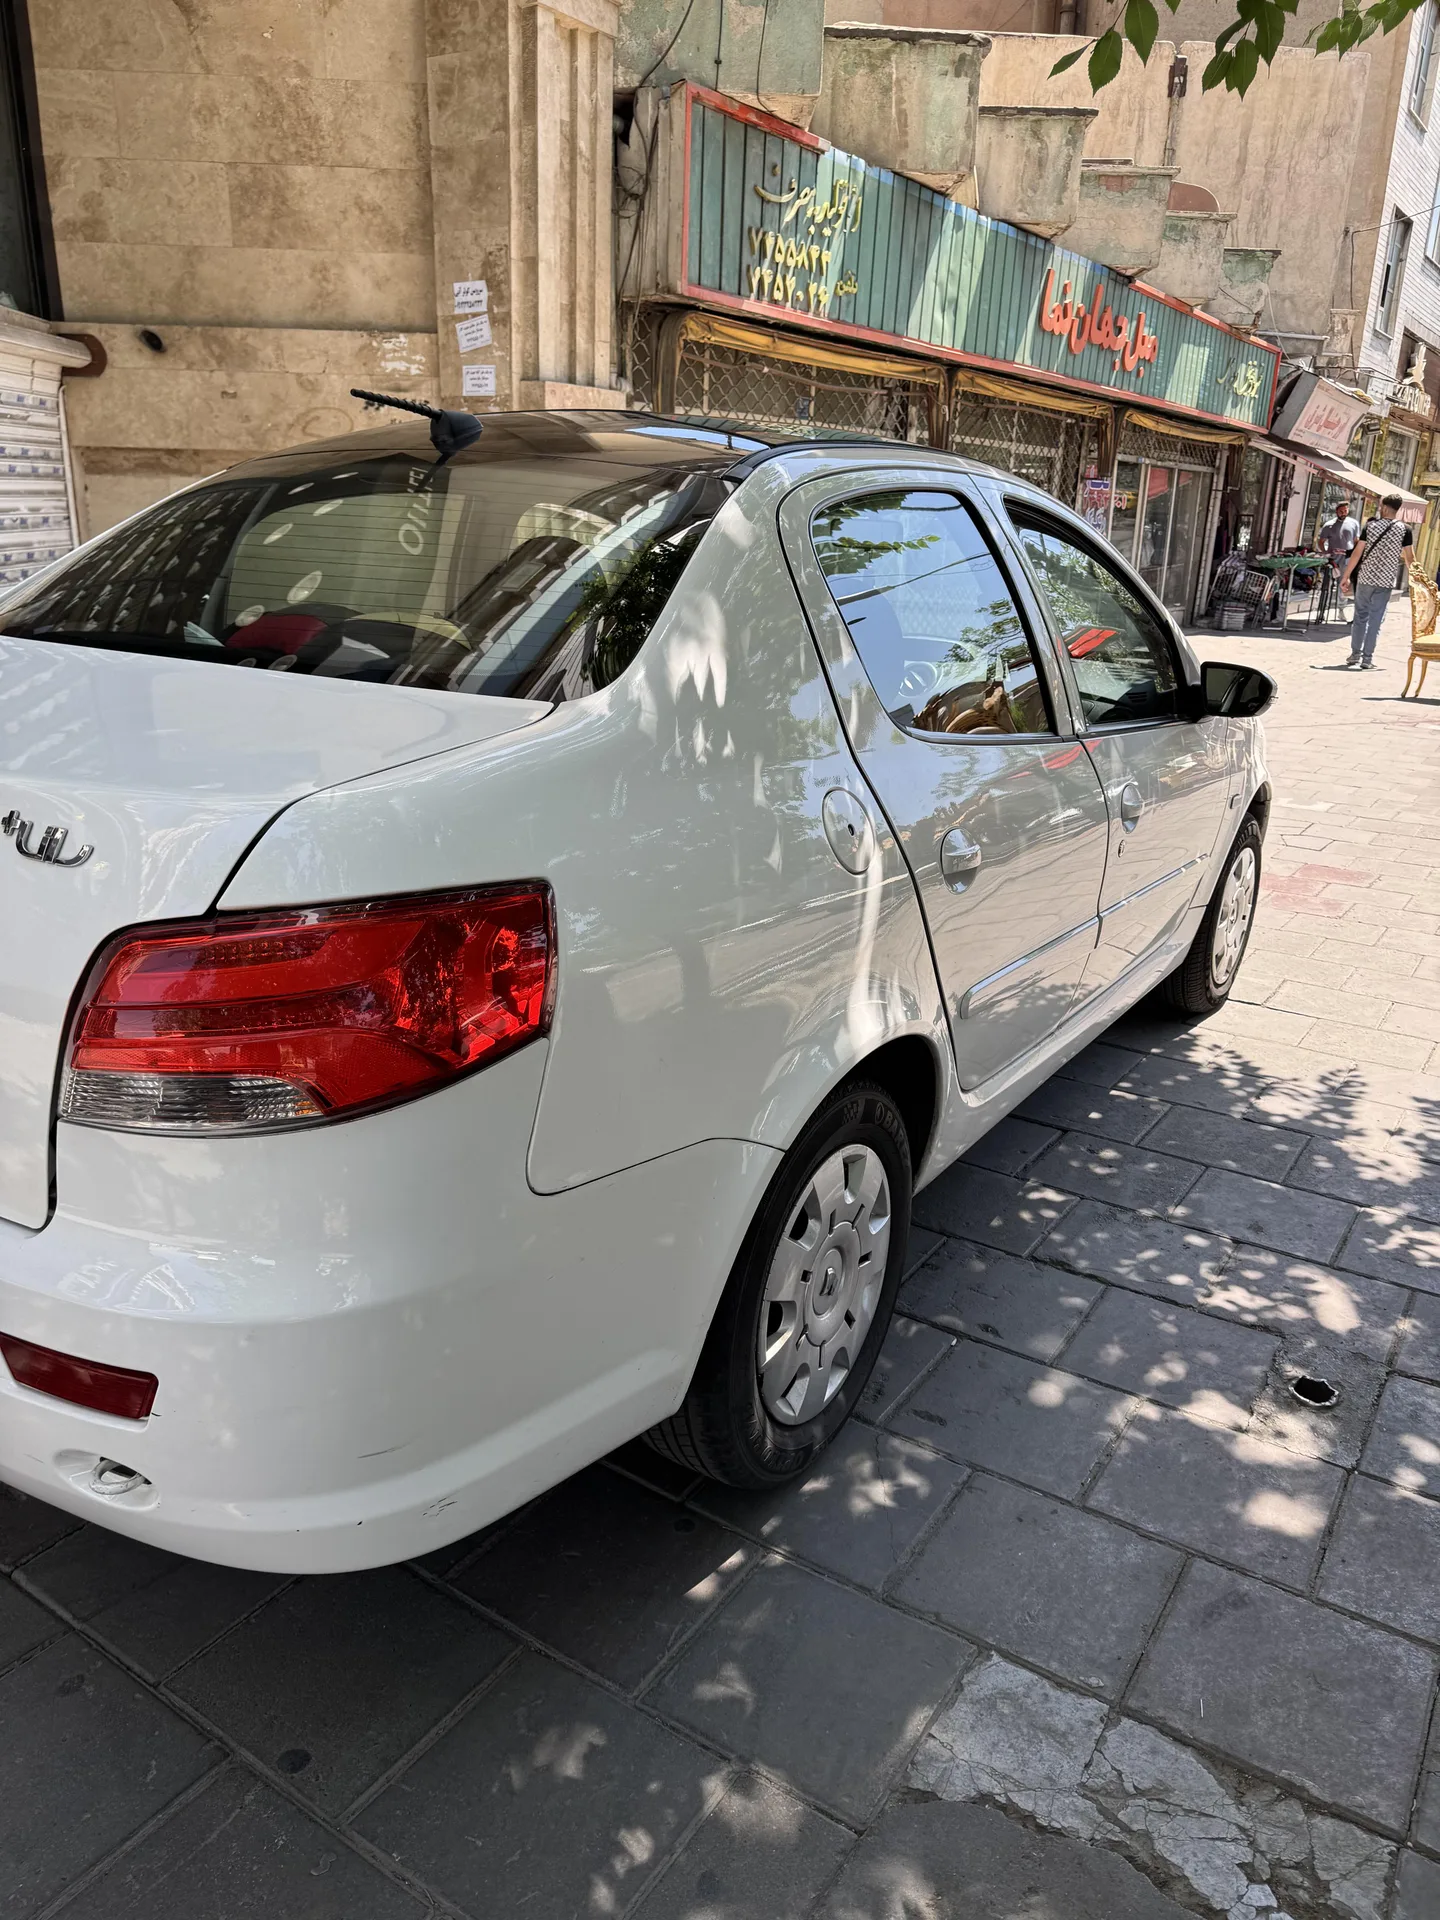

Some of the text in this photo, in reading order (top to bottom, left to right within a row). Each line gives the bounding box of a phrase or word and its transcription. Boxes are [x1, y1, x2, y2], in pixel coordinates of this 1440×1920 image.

[754, 163, 817, 224] مصرف
[1039, 267, 1073, 335] نما
[1069, 283, 1129, 371] جهان
[1123, 311, 1158, 378] مبل
